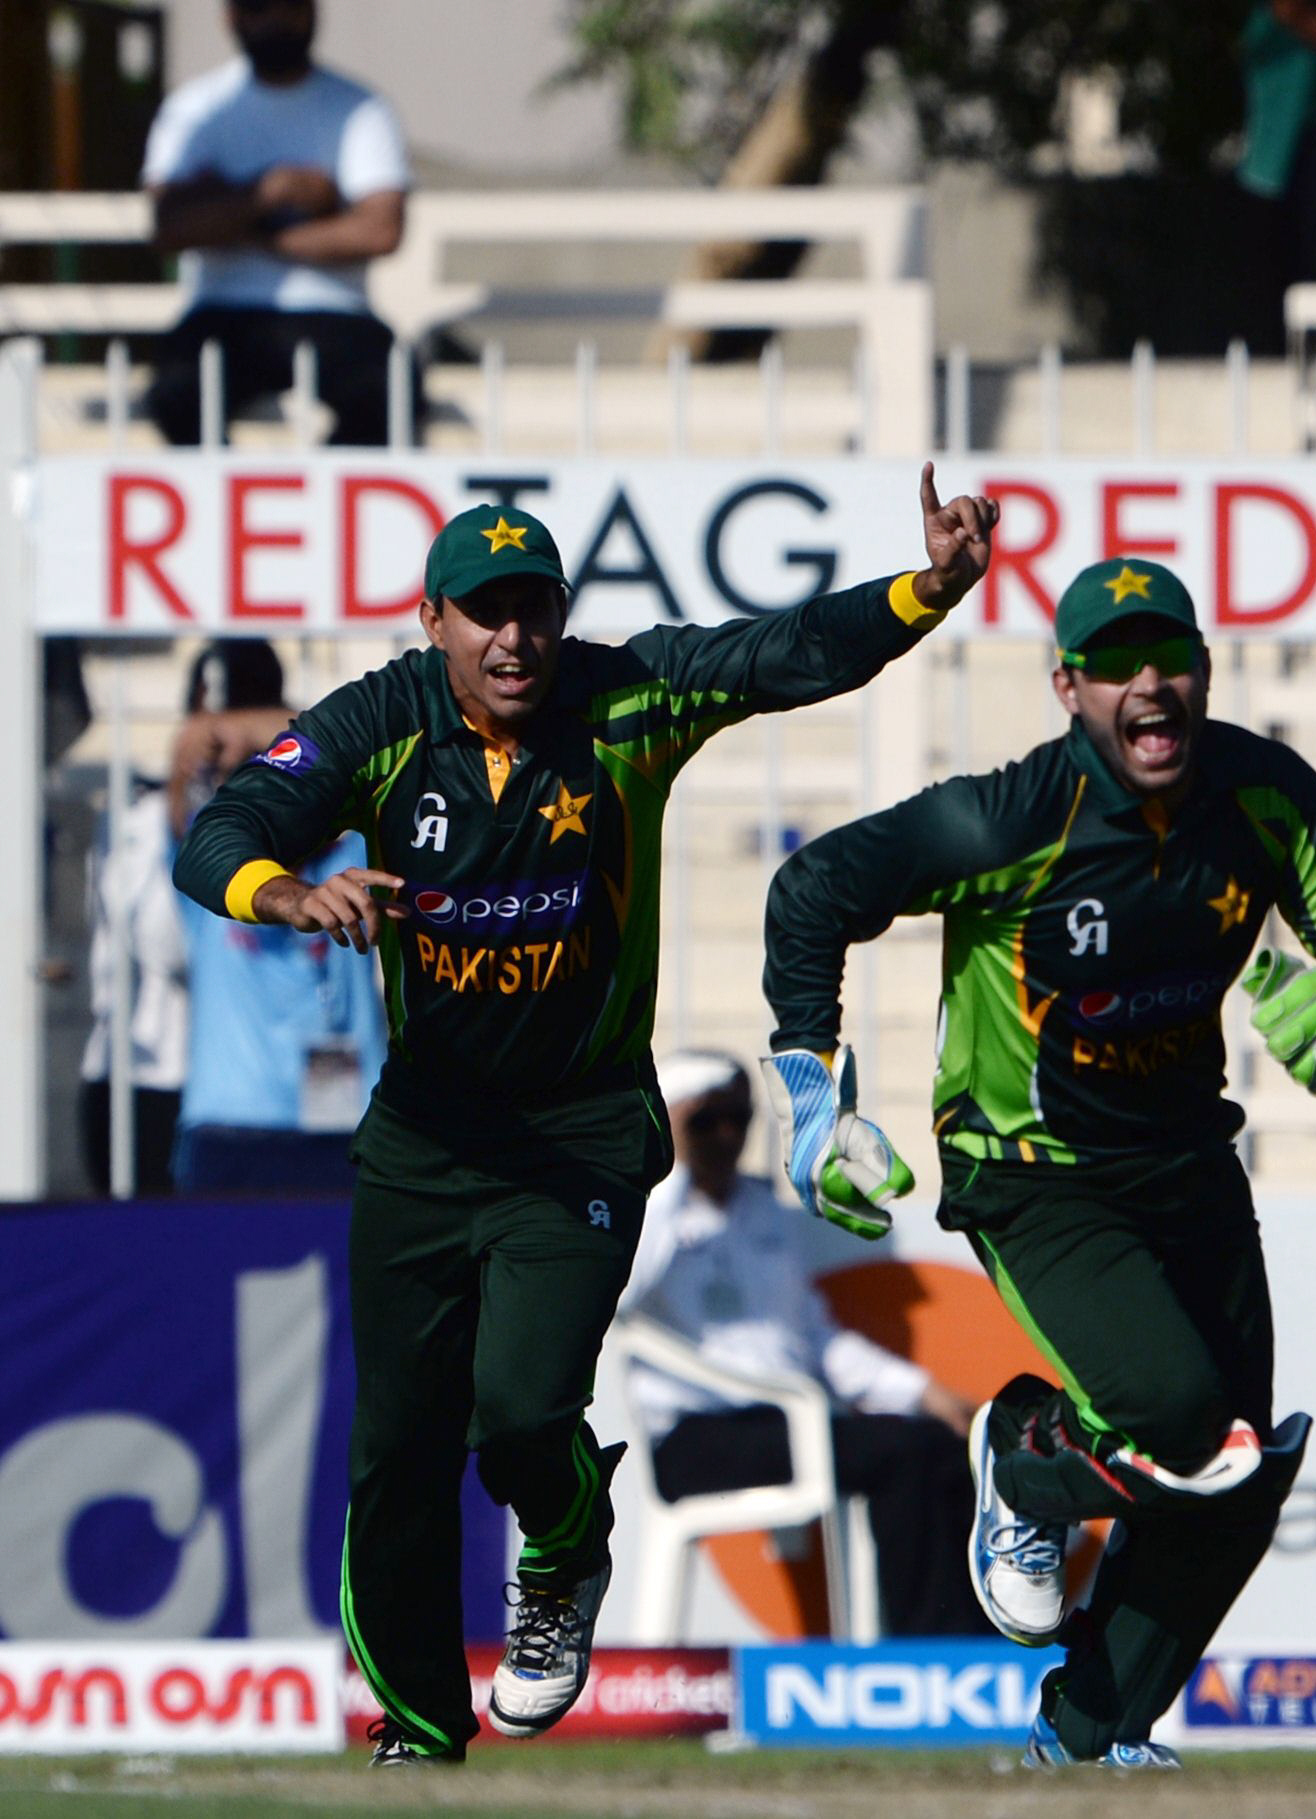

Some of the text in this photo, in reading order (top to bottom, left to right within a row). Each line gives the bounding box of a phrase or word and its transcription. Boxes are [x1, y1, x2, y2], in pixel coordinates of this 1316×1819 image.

[462, 881, 582, 924] pepsi
[416, 925, 592, 995] PAKISTAN
[765, 1662, 1042, 1728] NOKI
